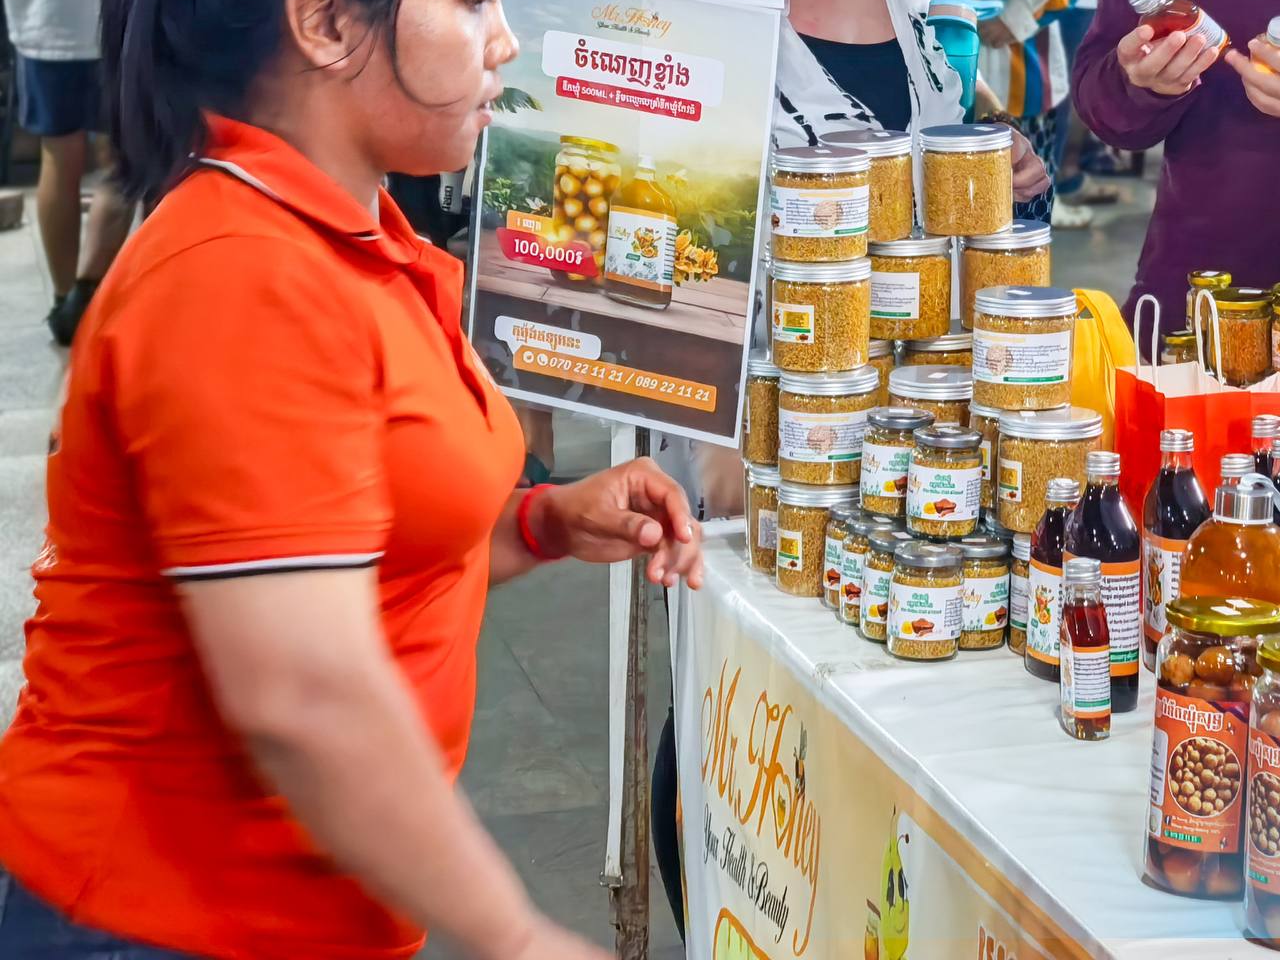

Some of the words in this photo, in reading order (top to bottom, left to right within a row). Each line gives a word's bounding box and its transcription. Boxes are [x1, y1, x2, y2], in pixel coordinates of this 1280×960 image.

[574, 39, 689, 90] ចំណេញខ្លាំង
[581, 86, 607, 99] 500ML
[549, 357, 571, 371] 070
[573, 362, 589, 374] 22
[591, 366, 606, 379] 11
[608, 369, 623, 383] 21
[635, 376, 658, 389] 089
[659, 380, 675, 393] 22
[678, 384, 692, 396] 11
[695, 388, 710, 401] 21
[701, 657, 742, 818] Mr.
[737, 689, 822, 956] Honey
[720, 826, 747, 889] Health
[755, 861, 790, 944] Beauty
